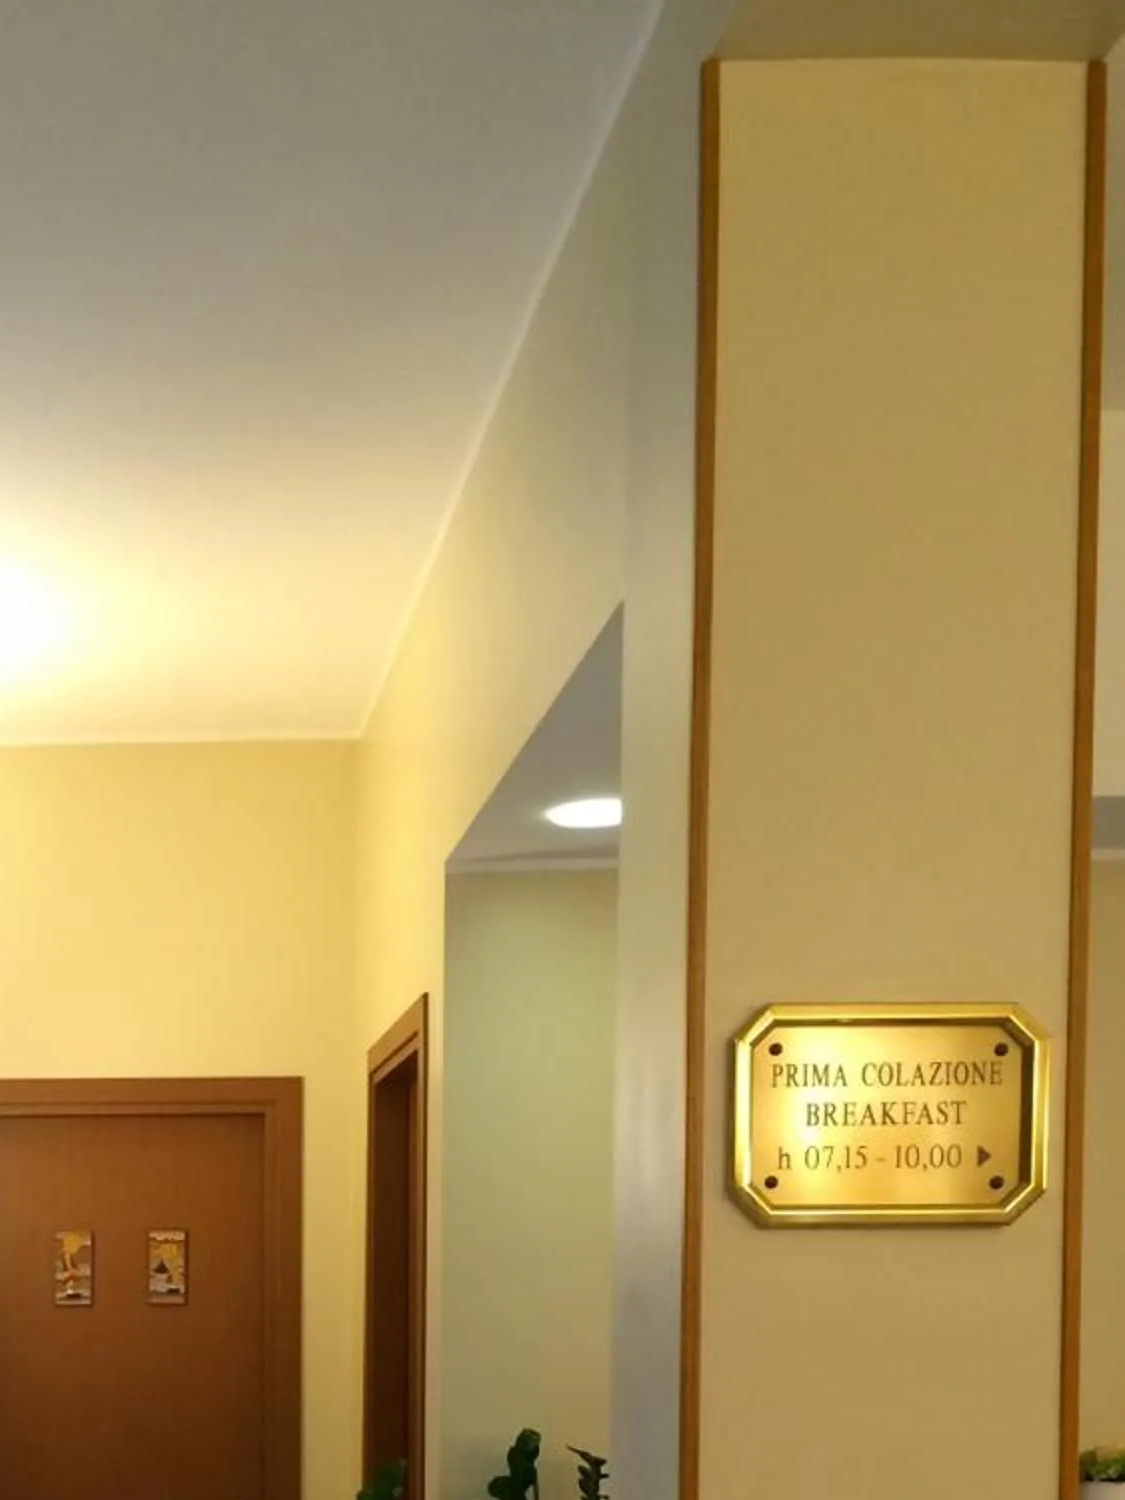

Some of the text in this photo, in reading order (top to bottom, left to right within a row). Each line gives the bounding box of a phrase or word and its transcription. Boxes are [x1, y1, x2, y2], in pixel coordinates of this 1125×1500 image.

[771, 1061, 1004, 1088] PRIMA COLAZIONE
[805, 1101, 967, 1127] BREAKFAST
[777, 1147, 792, 1170] h
[804, 1145, 868, 1172] 07,15
[894, 1144, 963, 1171] 10,00
